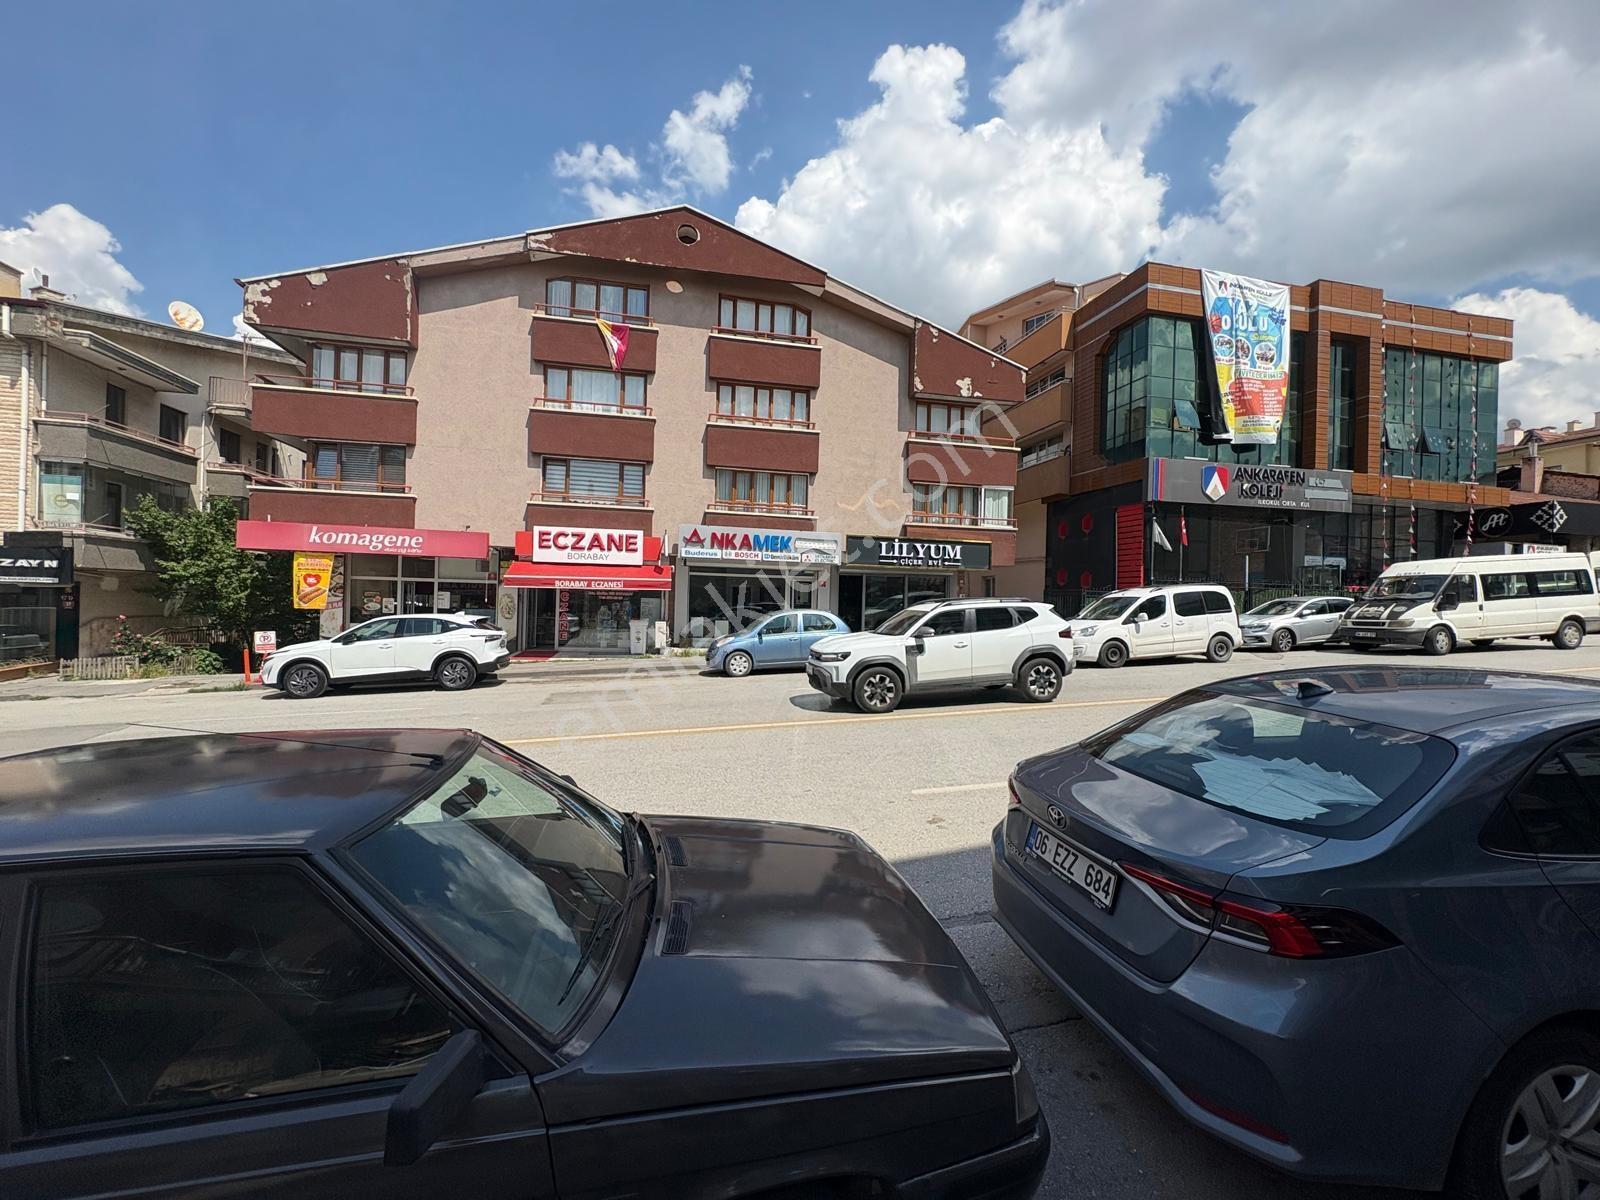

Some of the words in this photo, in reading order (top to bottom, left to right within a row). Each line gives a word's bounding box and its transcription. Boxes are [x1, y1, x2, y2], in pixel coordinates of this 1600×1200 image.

[1233, 467, 1306, 486] ANKARAFEN
[308, 525, 423, 552] komagene
[538, 531, 639, 553] ECZANE
[568, 552, 610, 561] BORABAY
[879, 539, 962, 560] LİLYUM
[555, 580, 588, 588] BORABAY
[591, 580, 624, 589] ECZANESİ
[1034, 830, 1049, 855] 06
[1052, 842, 1079, 876] EZZ
[1084, 863, 1112, 899] 684
